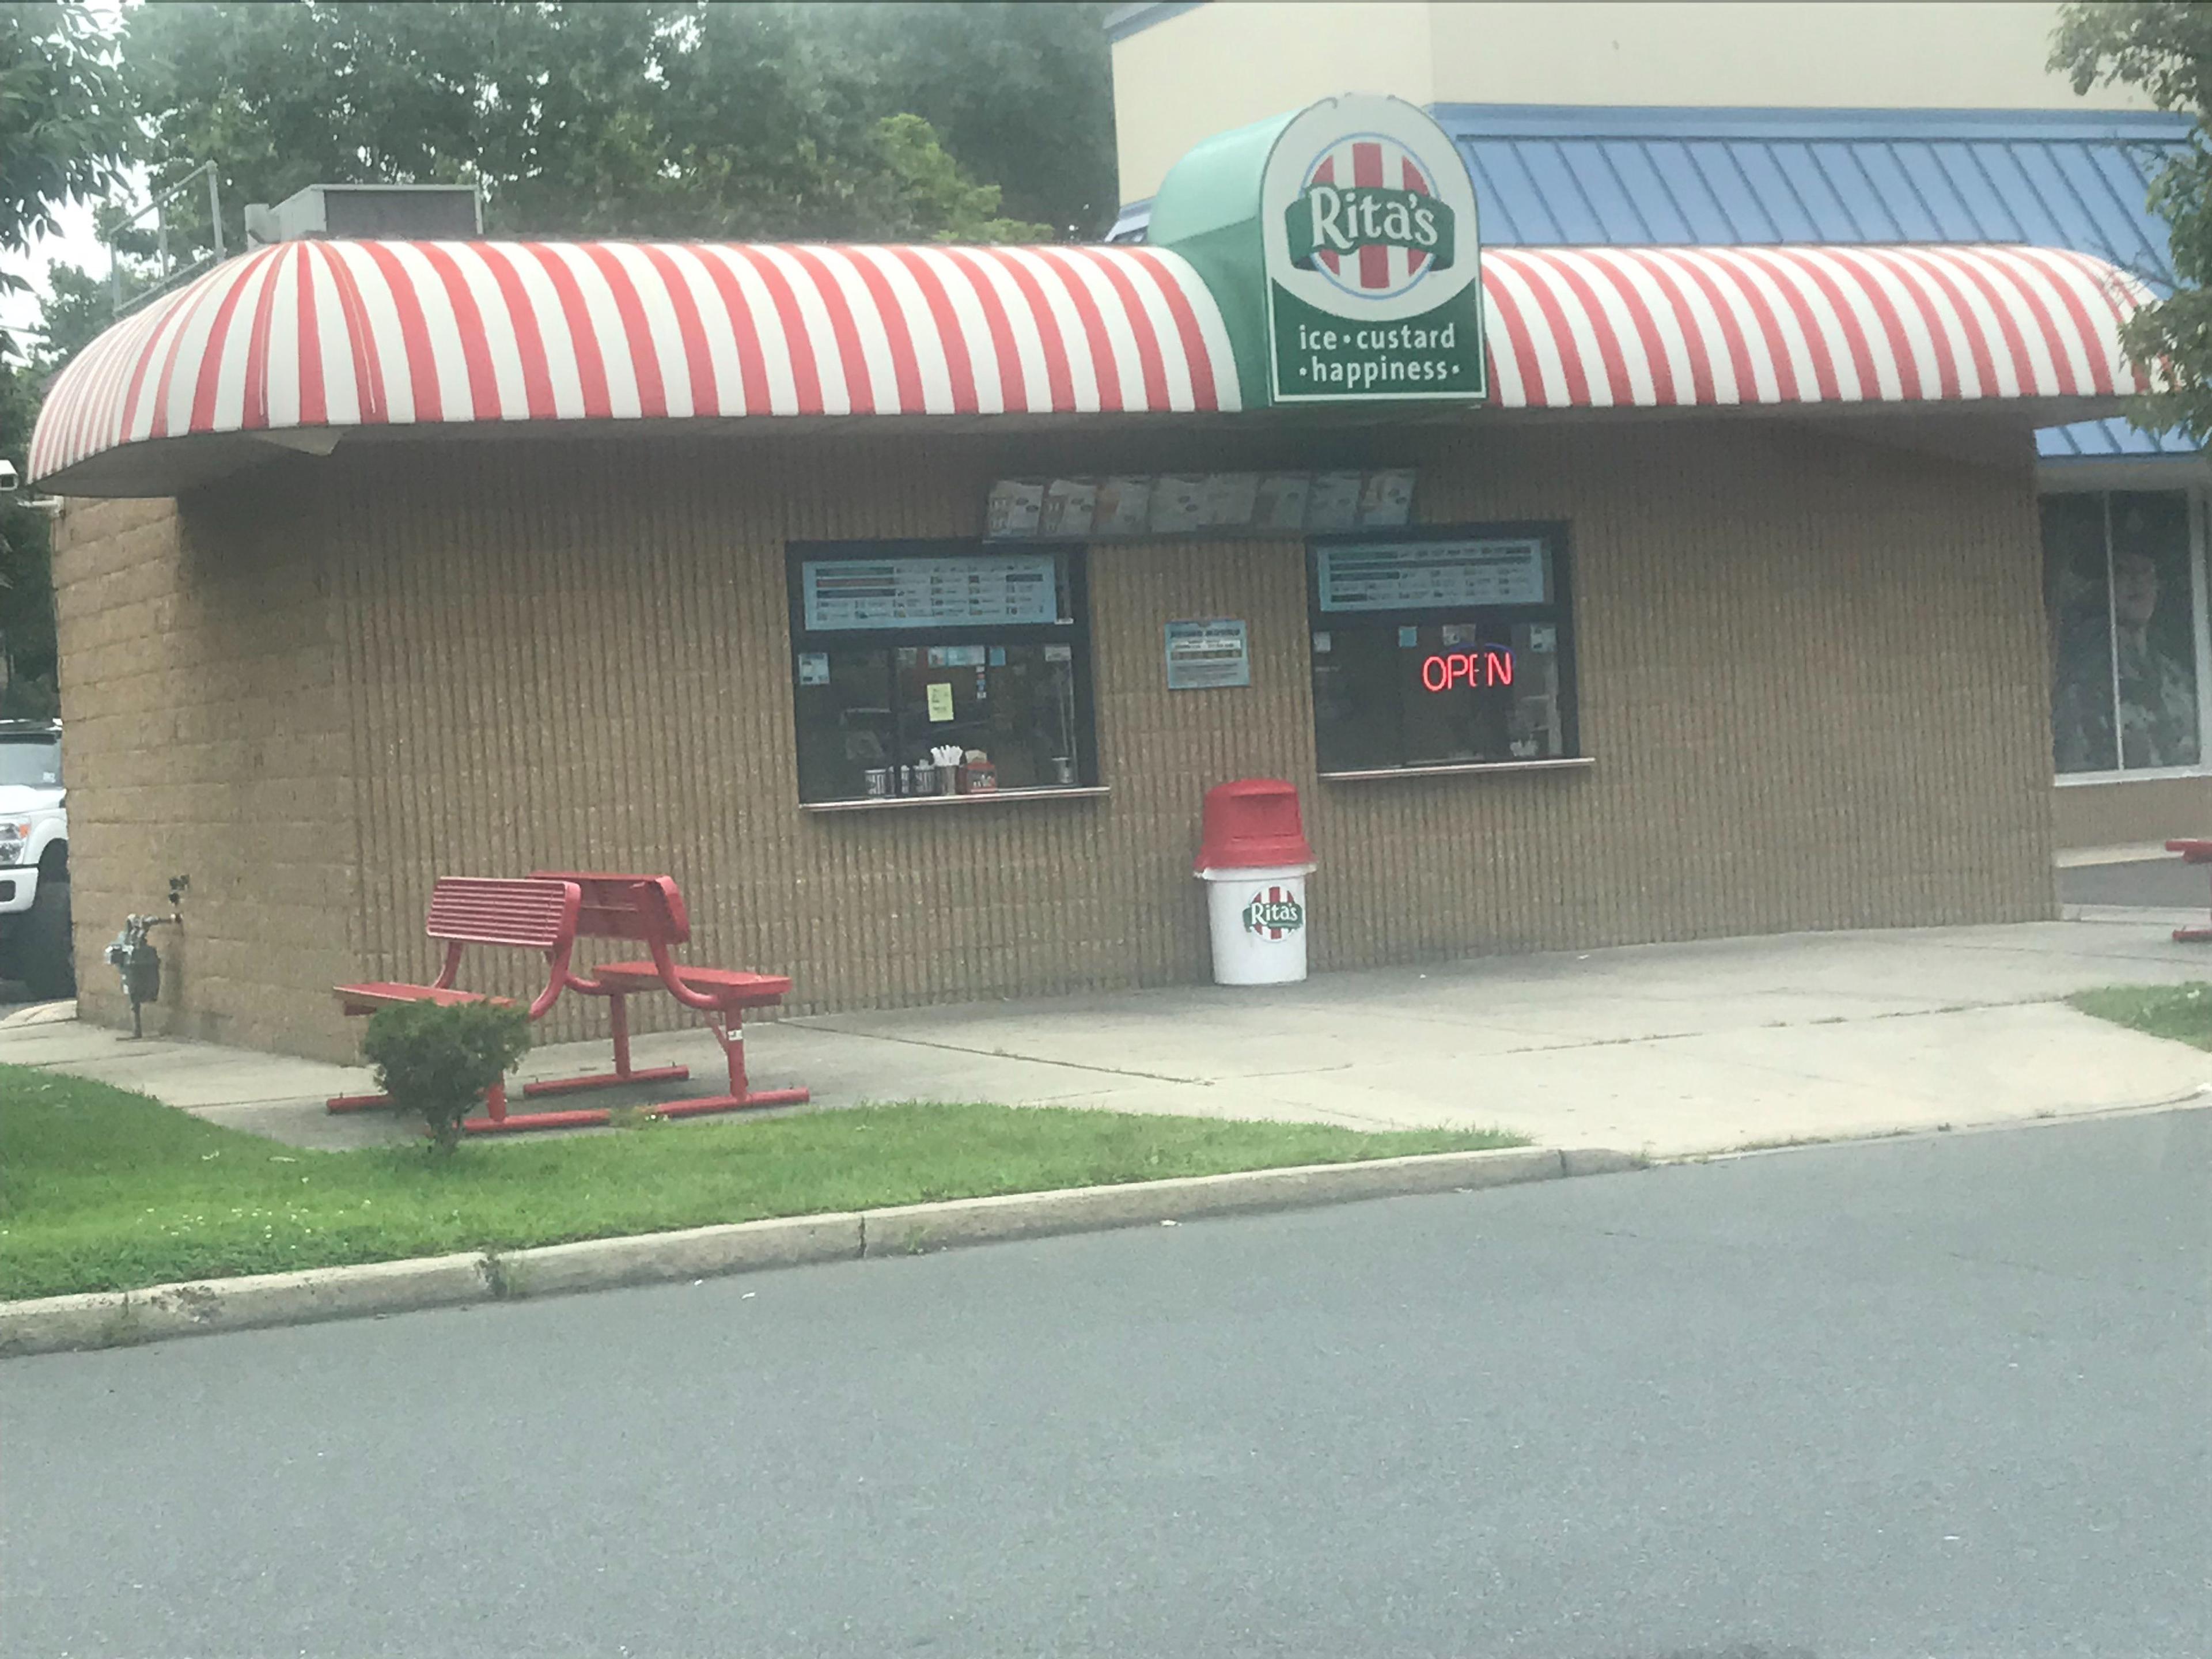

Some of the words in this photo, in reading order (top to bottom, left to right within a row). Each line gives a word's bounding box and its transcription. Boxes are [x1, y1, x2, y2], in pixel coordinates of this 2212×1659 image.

[1310, 186, 1438, 249] Rita's
[1300, 325, 1336, 350] ice
[1357, 323, 1455, 349] custard
[1312, 356, 1449, 388] happiness
[1422, 652, 1513, 692] OPEN
[1251, 902, 1298, 926] Rita's
